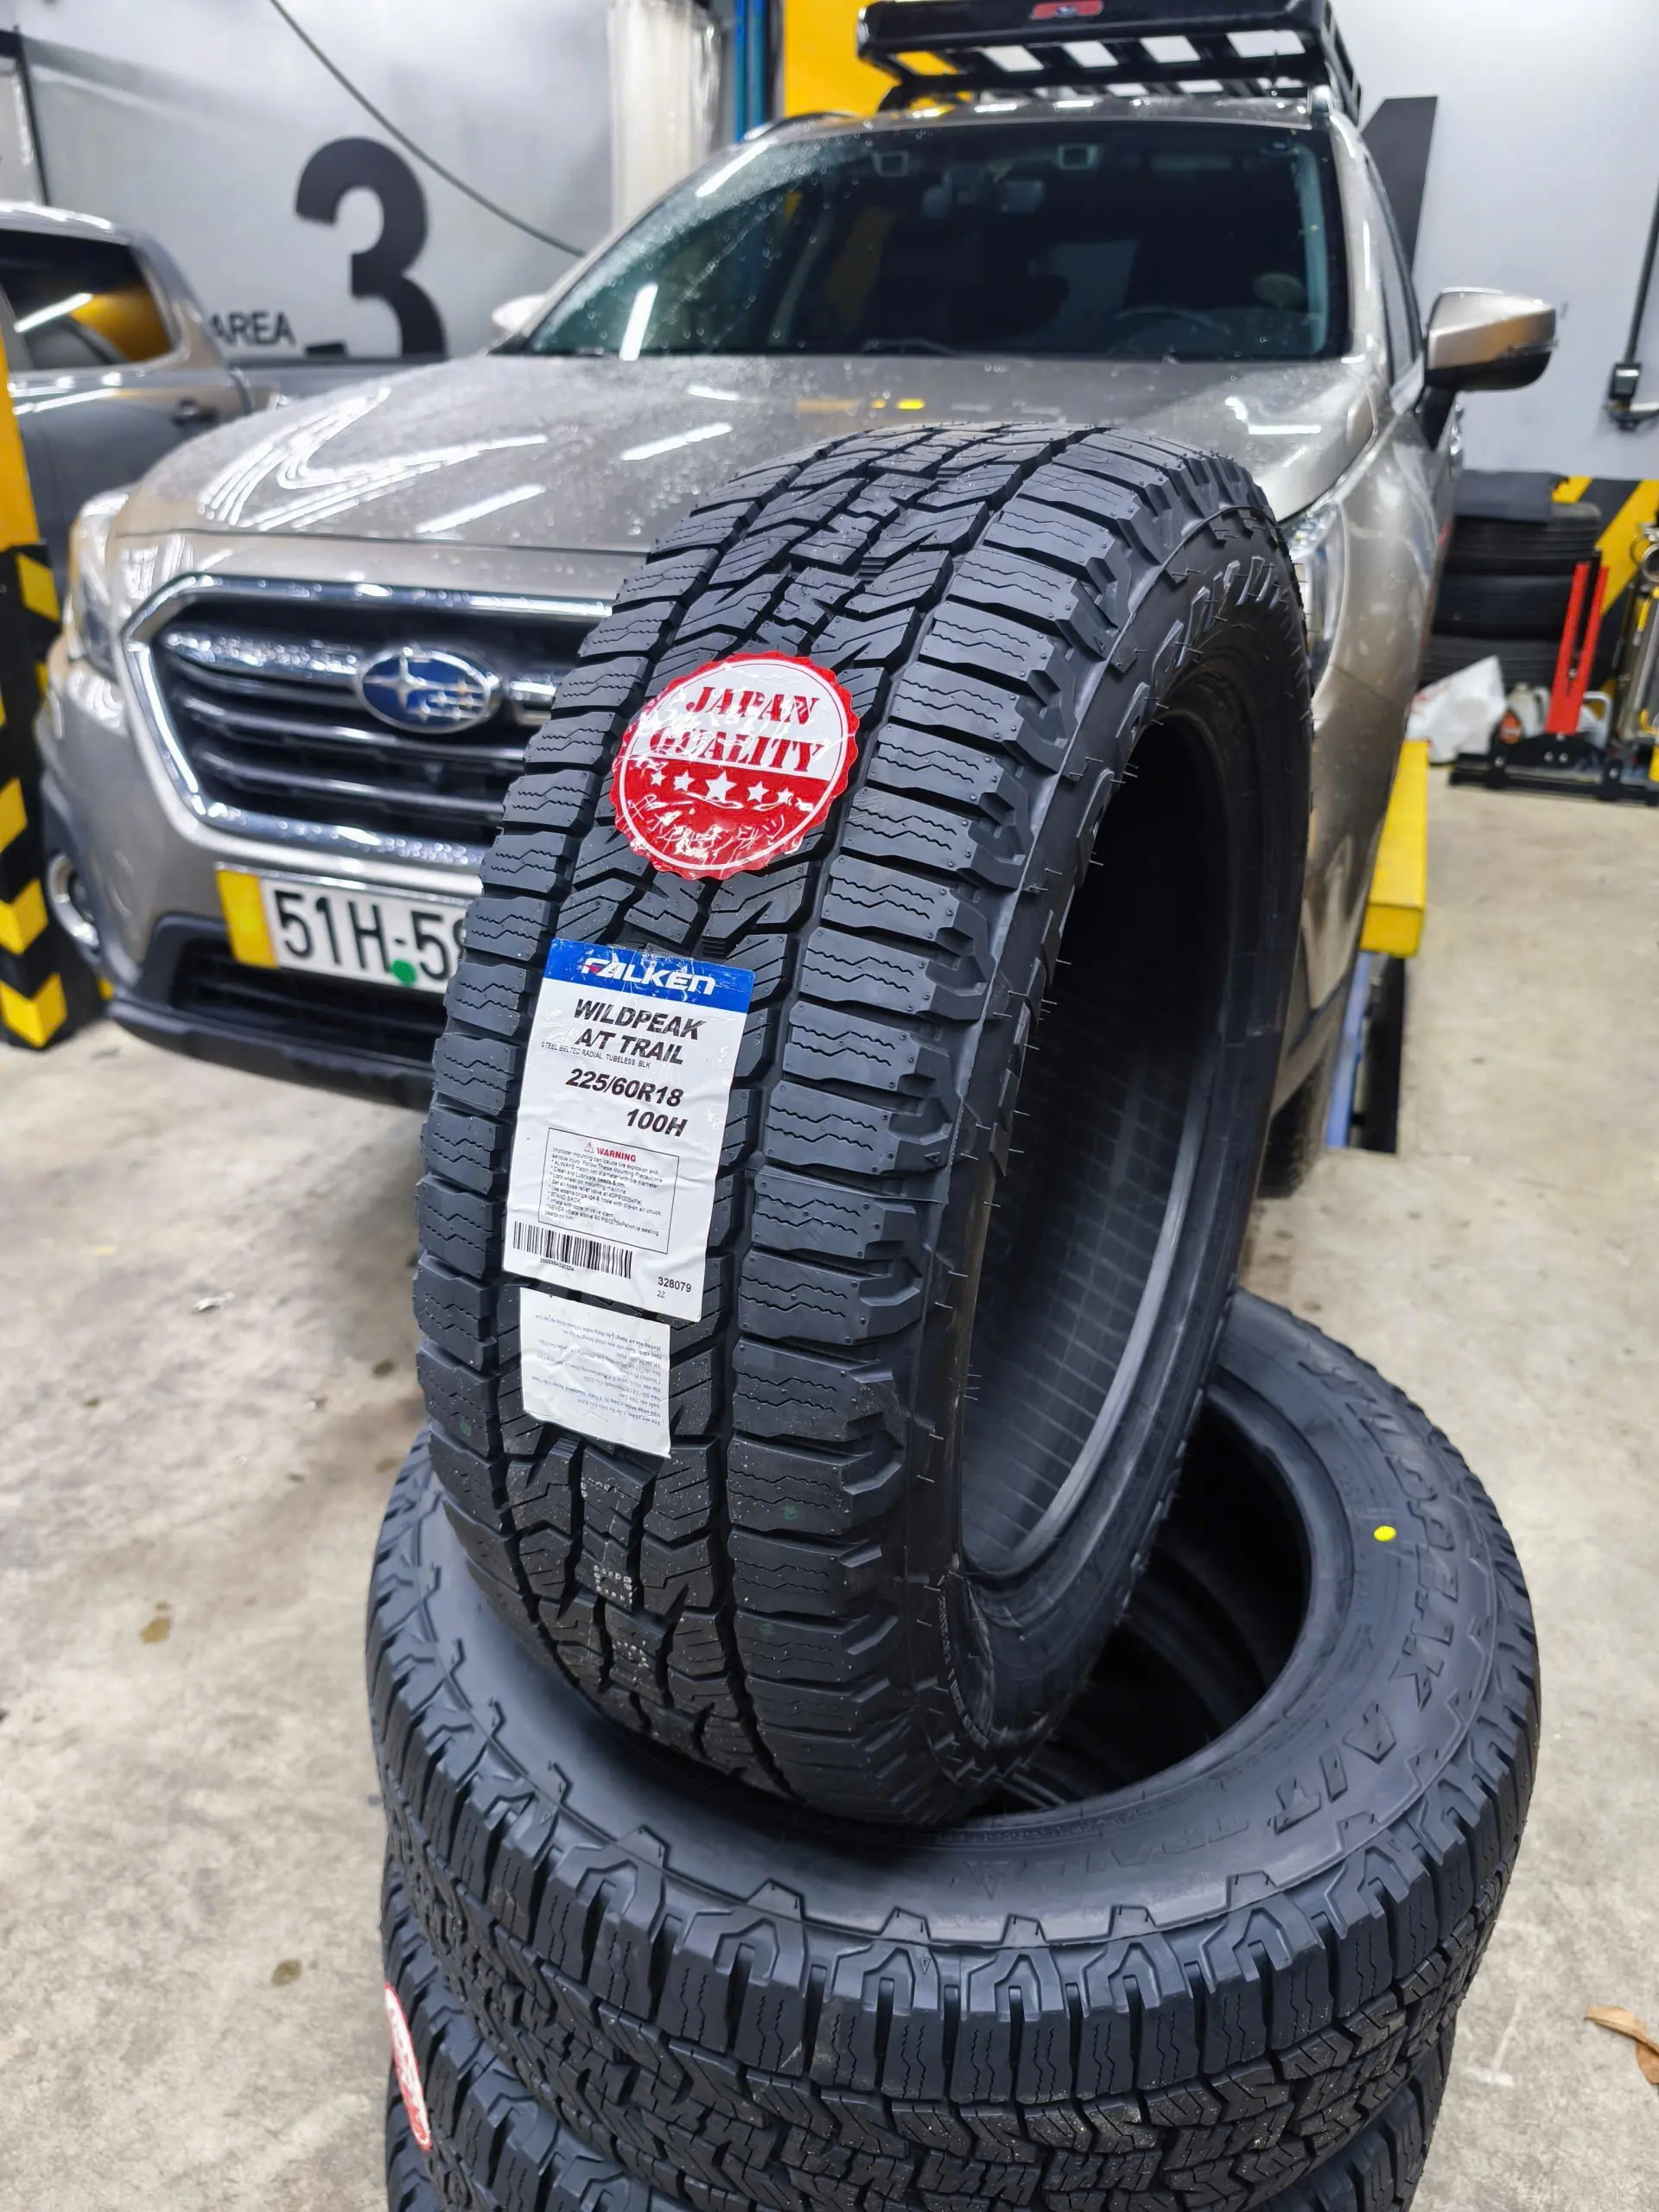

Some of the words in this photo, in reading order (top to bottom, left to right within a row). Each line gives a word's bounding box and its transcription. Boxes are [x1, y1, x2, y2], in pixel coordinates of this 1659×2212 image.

[296, 136, 448, 361] 3
[209, 311, 297, 346] AREA
[685, 685, 819, 725] JAPAN
[649, 726, 825, 772] QUALITY
[580, 957, 716, 996] FALKEN
[573, 998, 707, 1040] WILDPEAK
[574, 1027, 617, 1050] A/T
[620, 1034, 684, 1065] TRAIL
[582, 1047, 603, 1061] RADIAL
[605, 1052, 636, 1066] TUBELESS
[638, 1060, 651, 1069] BLK
[565, 1067, 684, 1107] 225/60R18
[626, 1108, 689, 1137] 100H
[596, 1147, 637, 1163] WARNING
[658, 1276, 692, 1294] 328079
